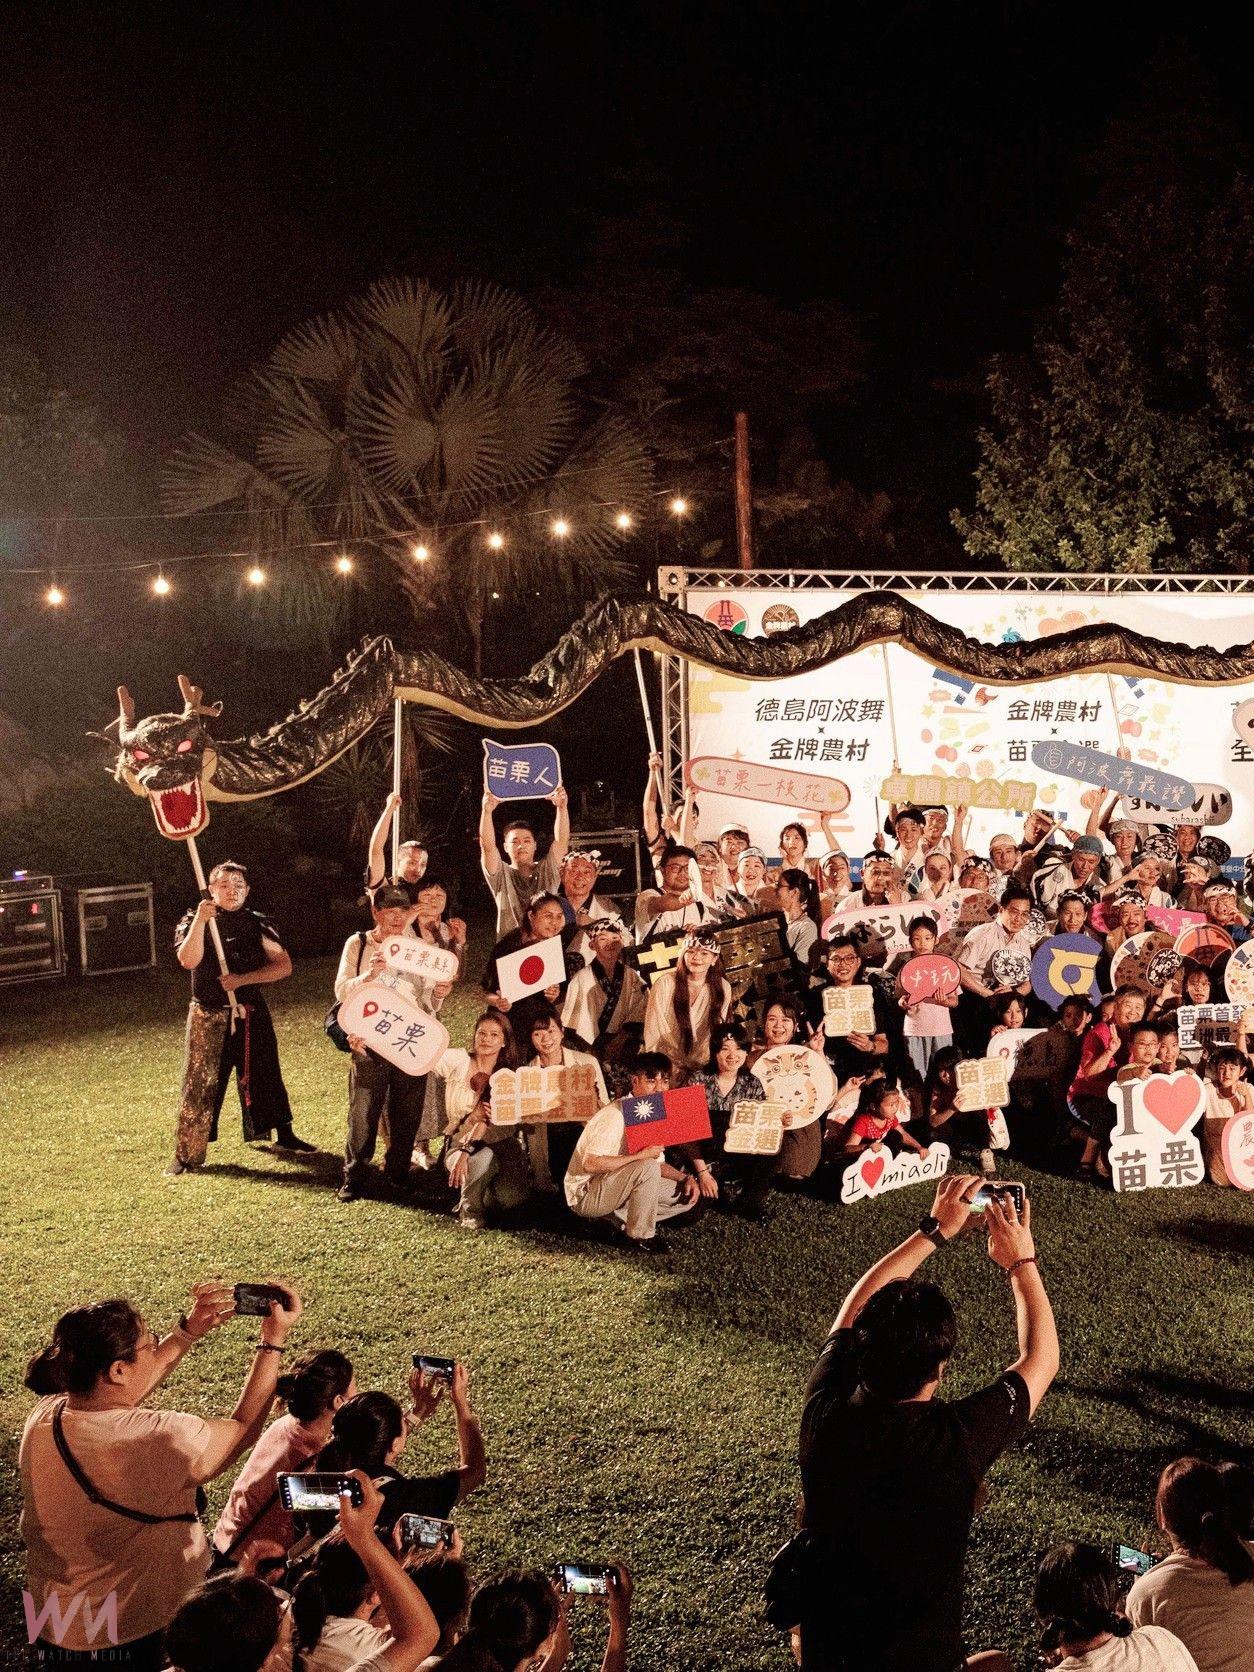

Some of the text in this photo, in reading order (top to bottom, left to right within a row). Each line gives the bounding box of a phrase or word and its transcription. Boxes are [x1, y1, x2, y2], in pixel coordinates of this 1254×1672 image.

[755, 698, 885, 723] 德島阿波舞
[1006, 699, 1102, 723] 金牌農村
[769, 738, 870, 762] 金牌農村
[489, 758, 553, 787] 苗栗人
[374, 1008, 426, 1058] 苗栗
[1114, 1082, 1143, 1137] I
[845, 1153, 946, 1198] I miaoli
[1114, 1140, 1199, 1192] 苗栗
